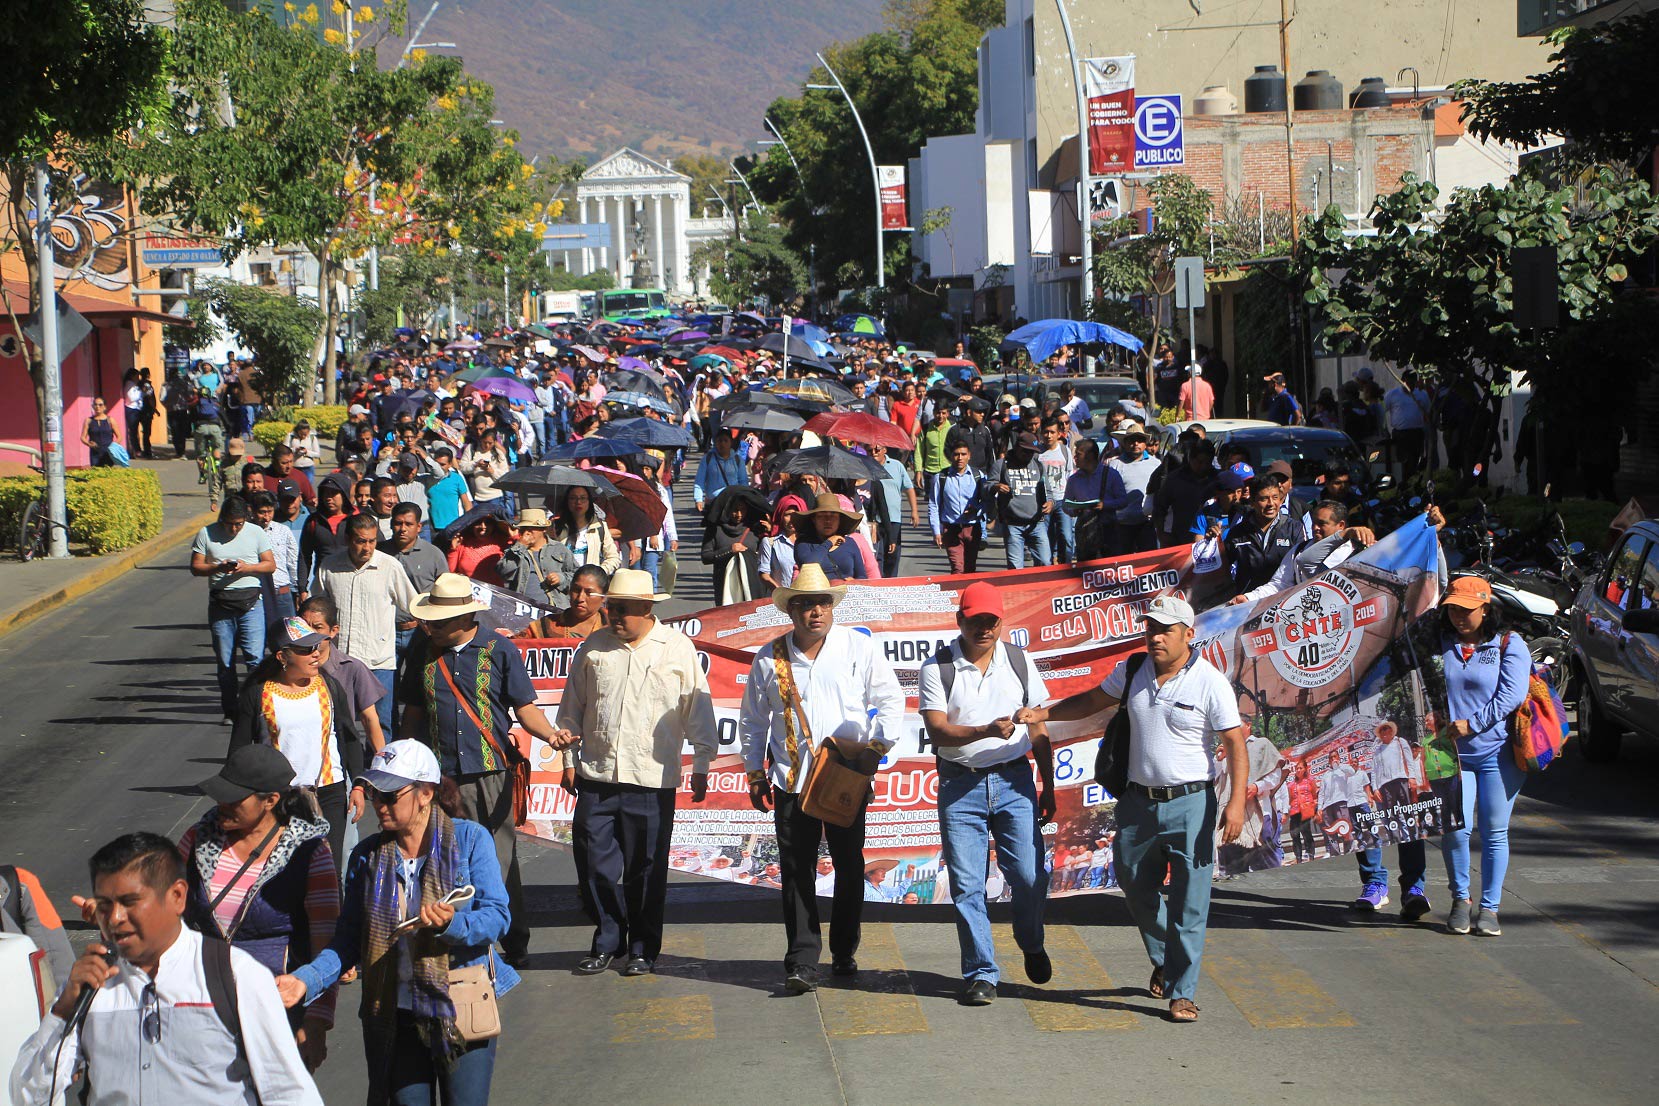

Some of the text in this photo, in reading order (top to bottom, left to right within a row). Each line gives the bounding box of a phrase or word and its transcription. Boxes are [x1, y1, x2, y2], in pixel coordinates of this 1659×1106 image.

[1146, 107, 1168, 138] E
[1136, 149, 1182, 164] PUBLICO
[1084, 567, 1136, 589] POR EL
[1355, 603, 1377, 621] 2019
[1042, 624, 1061, 640] DE
[1064, 618, 1085, 638] LA
[1285, 612, 1343, 643] CNTE
[1252, 633, 1274, 649] 1979
[1297, 642, 1320, 667] 40
[527, 786, 577, 815] GEPO
[1356, 796, 1443, 823] Prensa y Propaganda
[865, 809, 905, 822] RATACIÓN
[705, 823, 715, 832] DE
[888, 825, 904, 834] LAS
[905, 823, 931, 833] BECAS
[694, 836, 741, 845] INCIDENCIAS
